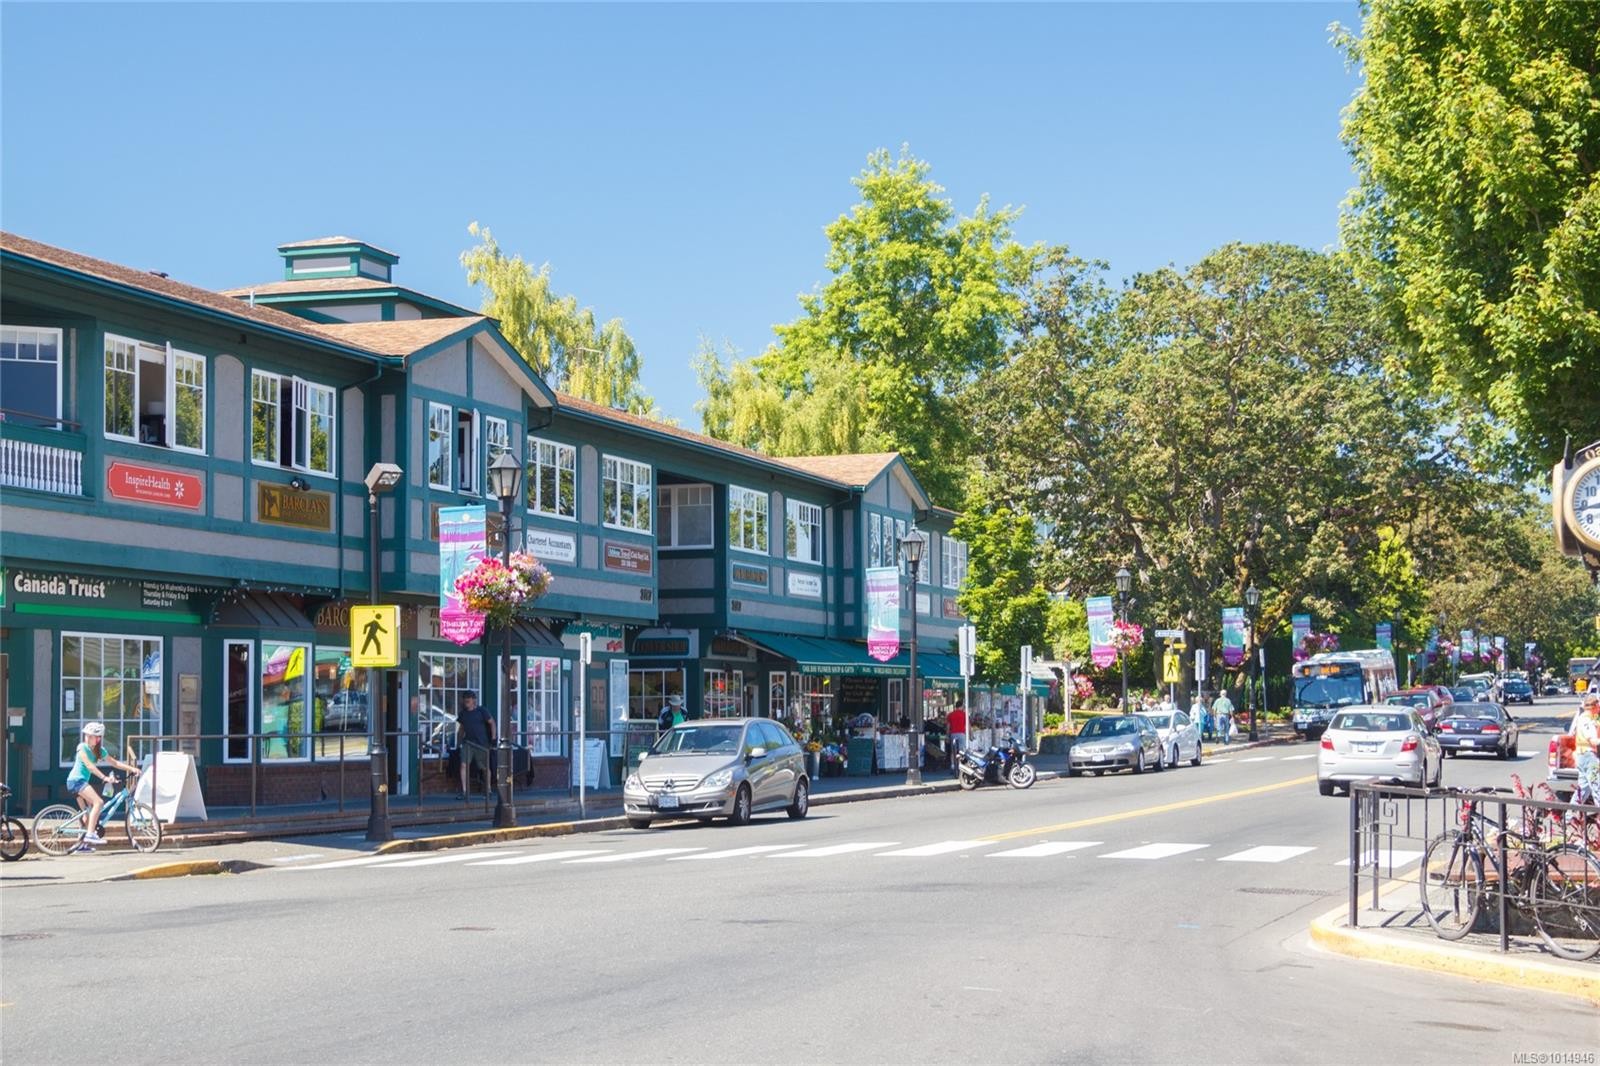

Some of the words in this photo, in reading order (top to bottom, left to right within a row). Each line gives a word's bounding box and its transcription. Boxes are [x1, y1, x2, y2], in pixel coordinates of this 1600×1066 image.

[125, 472, 171, 489] InspireHealth
[1585, 486, 1597, 497] 10
[283, 495, 328, 513] BARCLAYS
[1586, 513, 1594, 525] 8
[548, 536, 572, 551] Accountants
[14, 574, 66, 595] Canada
[69, 578, 105, 598] Trust
[317, 606, 349, 628] BARC
